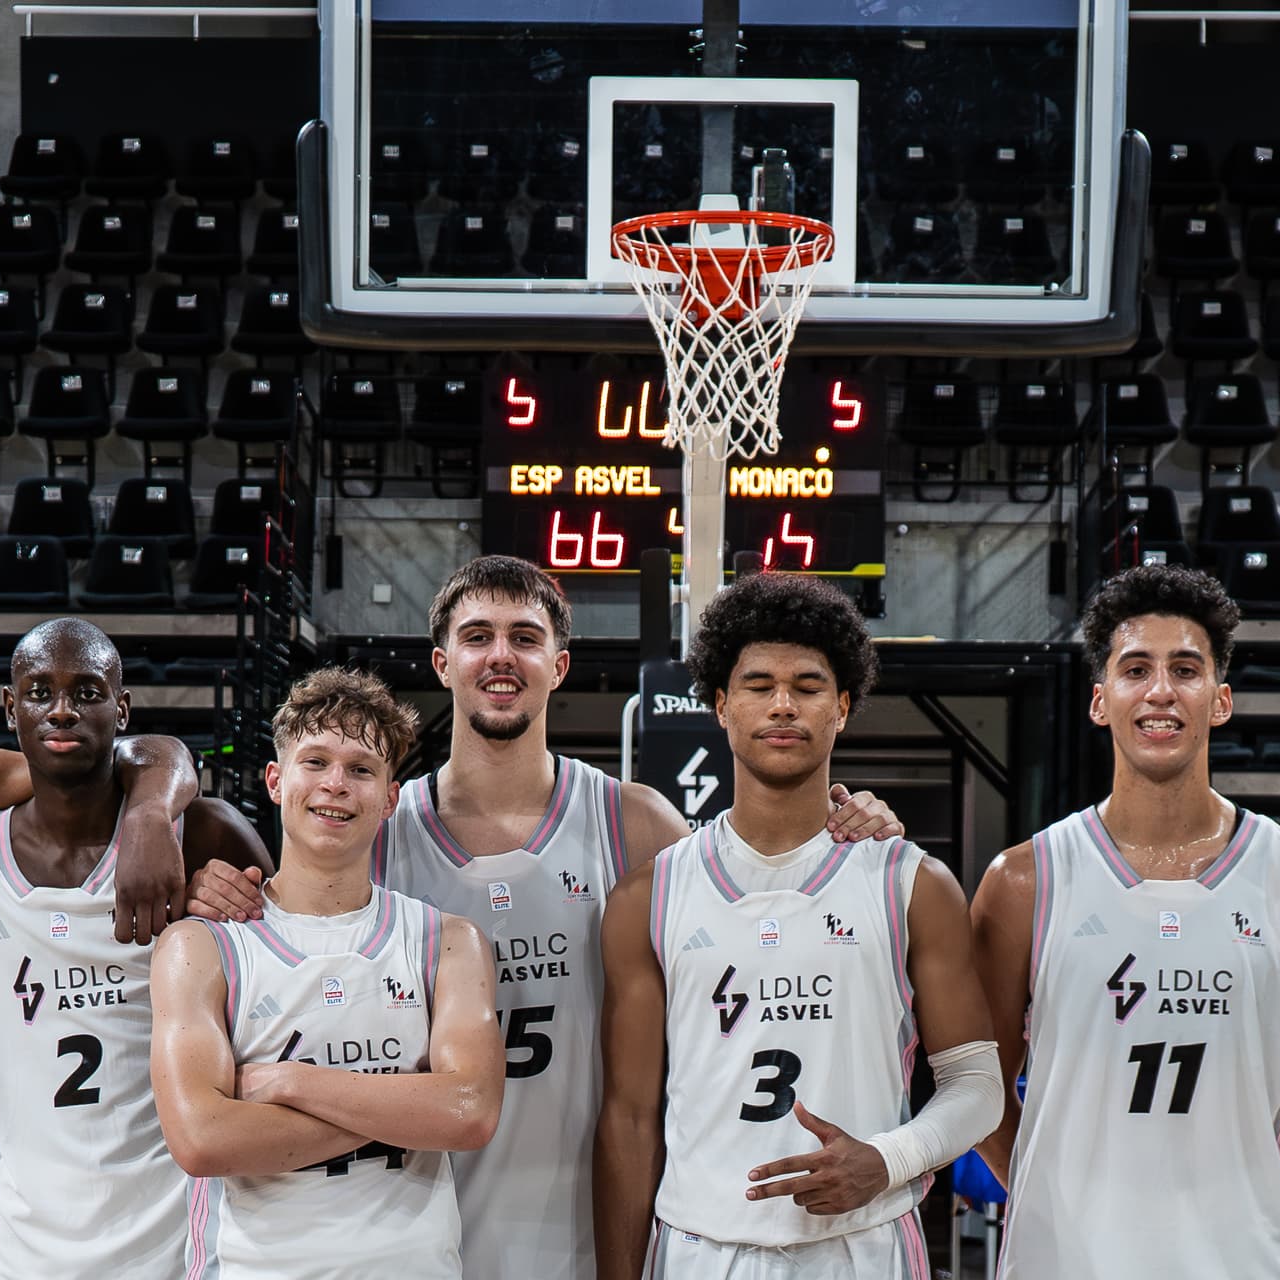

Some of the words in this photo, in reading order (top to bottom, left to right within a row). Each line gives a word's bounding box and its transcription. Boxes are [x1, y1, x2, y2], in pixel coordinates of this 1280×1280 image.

[510, 465, 563, 495] ESP
[574, 466, 662, 496] ASVEL
[729, 467, 834, 498] MONACO
[495, 932, 568, 962] LDLC
[53, 965, 126, 990] LDLC
[498, 960, 571, 984] ASVEL
[1158, 969, 1233, 993] LDLC
[57, 988, 128, 1011] ASVEL
[759, 974, 833, 1001] LDLC
[759, 1003, 833, 1023] ASVEL
[1158, 997, 1230, 1016] ASVEL
[326, 1037, 401, 1065] LDLC
[499, 1004, 555, 1079] 5
[53, 1034, 103, 1108] 2
[1126, 1042, 1208, 1114] 11
[738, 1048, 802, 1124] 3
